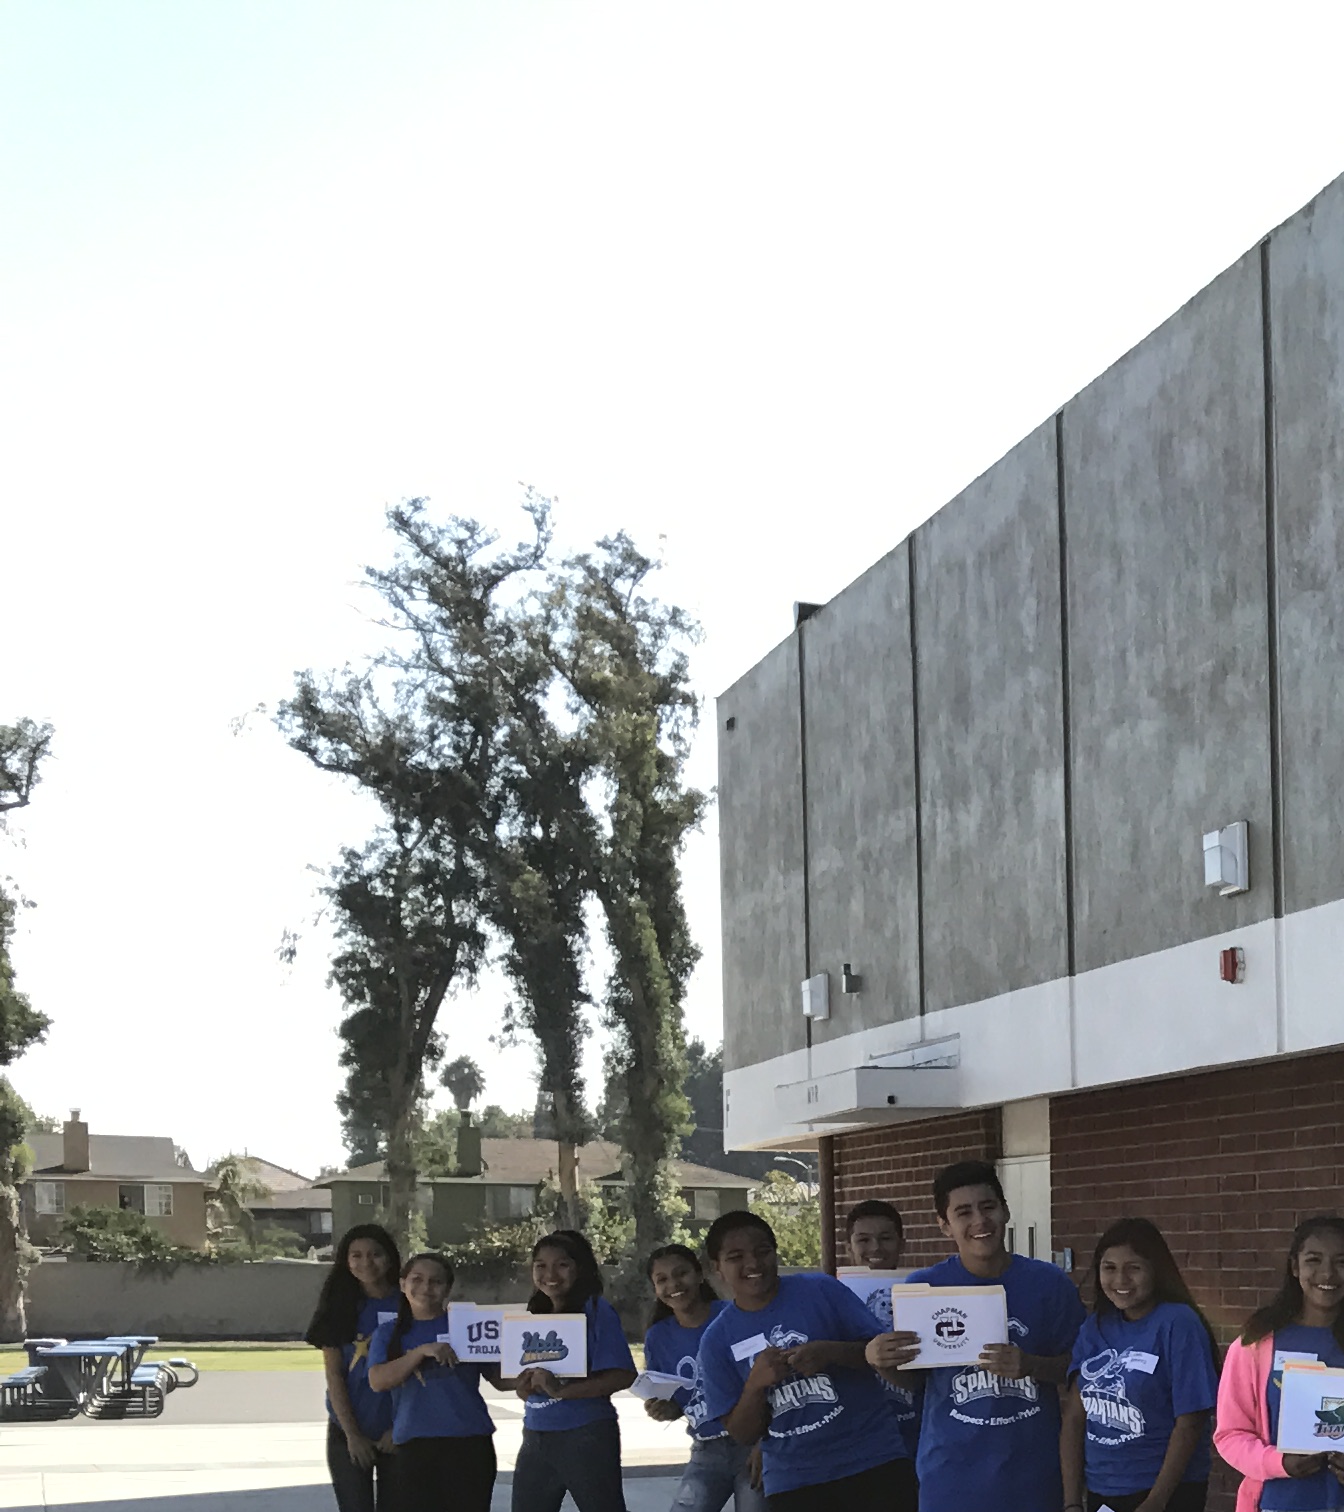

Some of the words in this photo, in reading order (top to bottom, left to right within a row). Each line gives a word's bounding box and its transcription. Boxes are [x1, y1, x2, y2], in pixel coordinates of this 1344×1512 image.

[467, 1320, 500, 1343] US
[467, 1345, 502, 1355] TROJA
[772, 1375, 836, 1408] ARTANS
[1082, 1397, 1142, 1435] PARTANS
